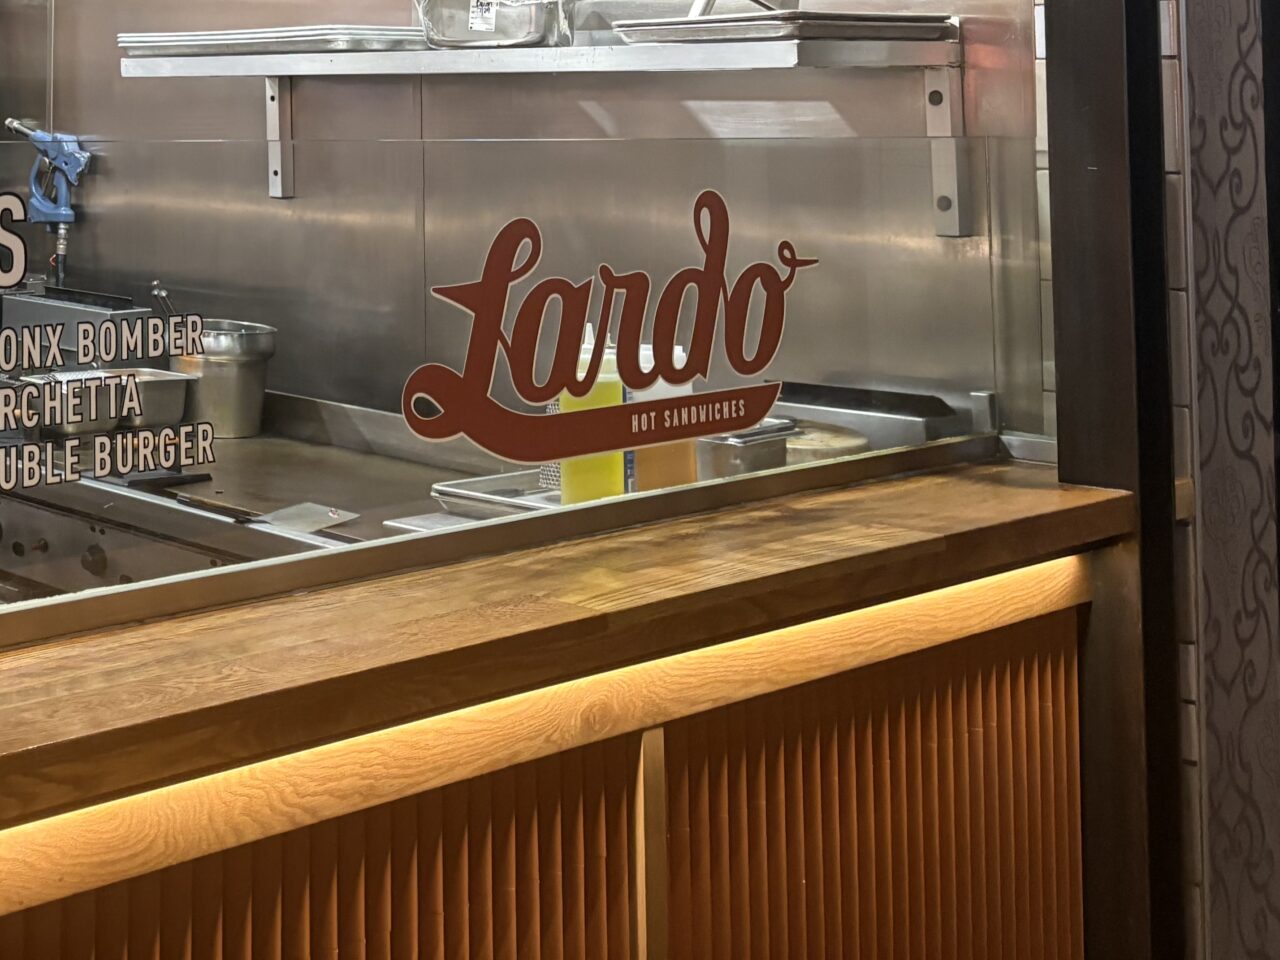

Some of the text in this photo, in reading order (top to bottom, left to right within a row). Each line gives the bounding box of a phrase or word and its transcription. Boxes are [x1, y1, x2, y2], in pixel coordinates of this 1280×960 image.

[76, 313, 206, 366] BOMBER
[401, 189, 819, 464] Lardo
[631, 399, 745, 433] HOT SANDWICHES
[93, 421, 217, 479] BURGER
